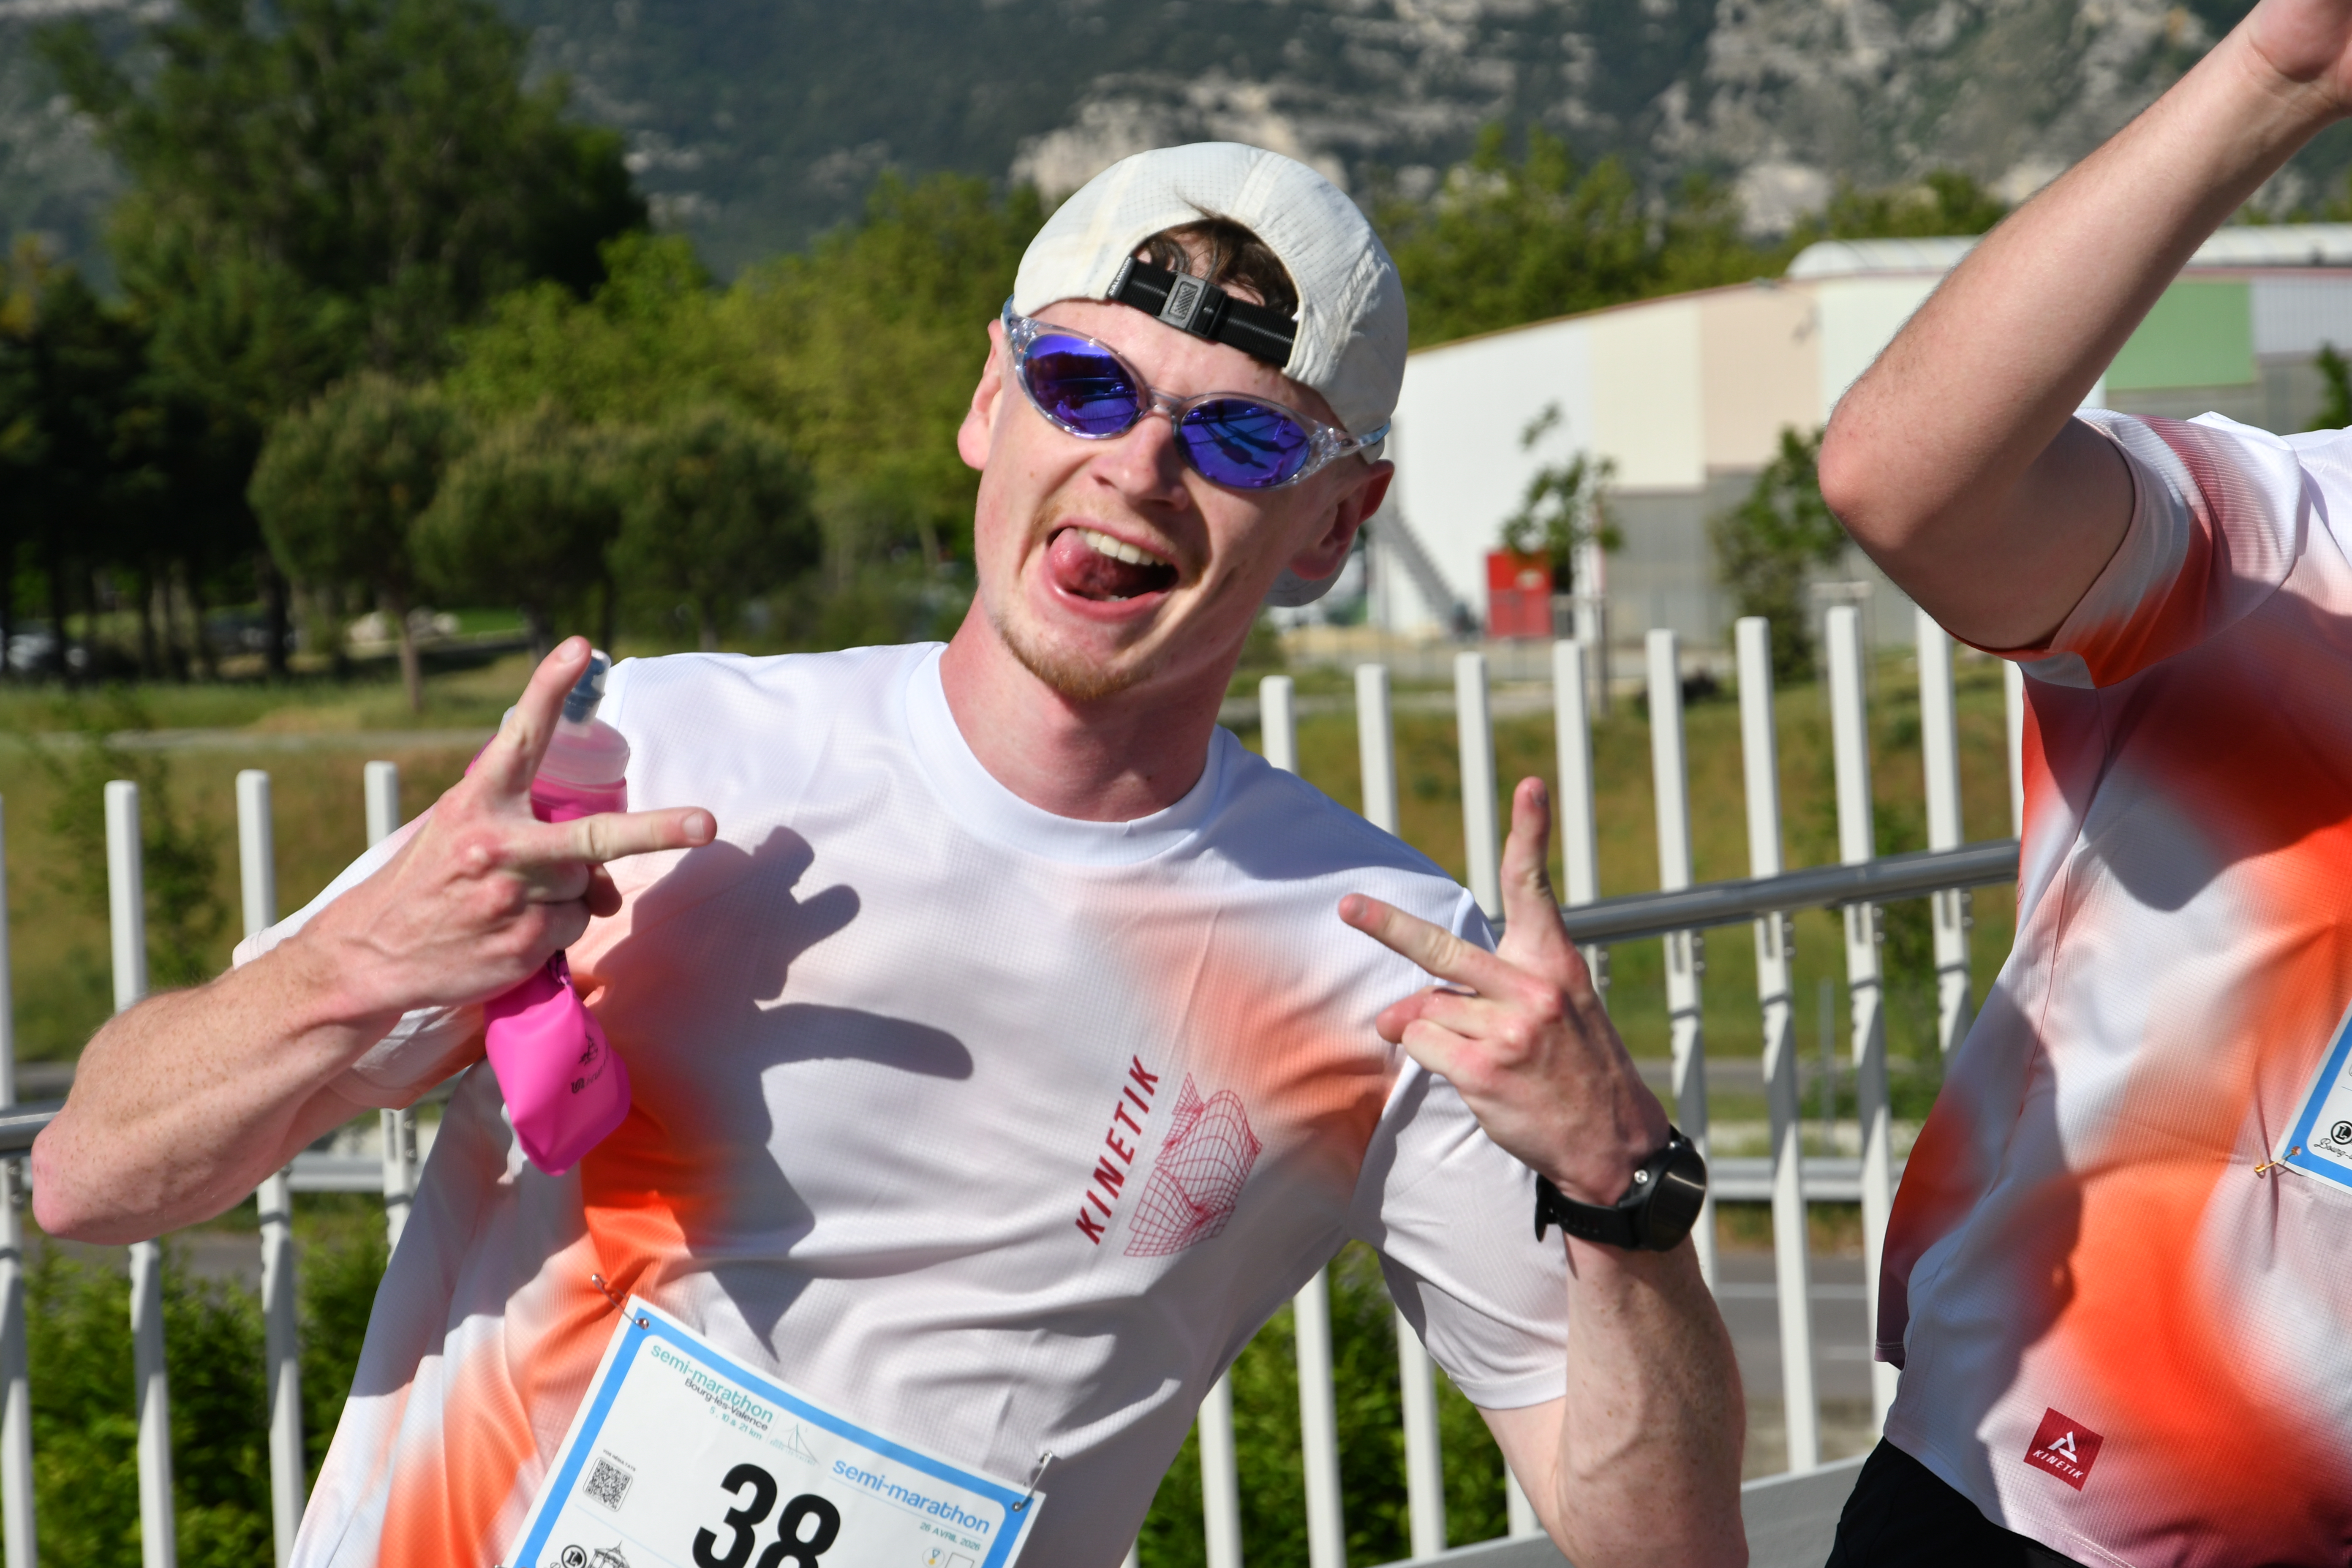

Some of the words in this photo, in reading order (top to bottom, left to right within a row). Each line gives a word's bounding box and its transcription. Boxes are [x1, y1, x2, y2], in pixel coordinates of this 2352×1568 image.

[1108, 256, 1131, 296] SALOMON
[1075, 1054, 1159, 1245] KINETIK
[651, 1345, 773, 1423] semi-marathon
[684, 1377, 768, 1431] Bourg-lès-Valence
[721, 1413, 730, 1423] 10
[730, 1418, 736, 1427] &
[738, 1422, 748, 1432] 21
[749, 1428, 762, 1440] km
[603, 1448, 612, 1457] VOS
[2032, 1449, 2084, 1478] KINETIK
[692, 1463, 841, 1568] 38
[832, 1460, 990, 1535] semi-marathon
[920, 1522, 932, 1532] 26
[932, 1527, 958, 1544] AVRIL
[959, 1538, 981, 1552] 2026
